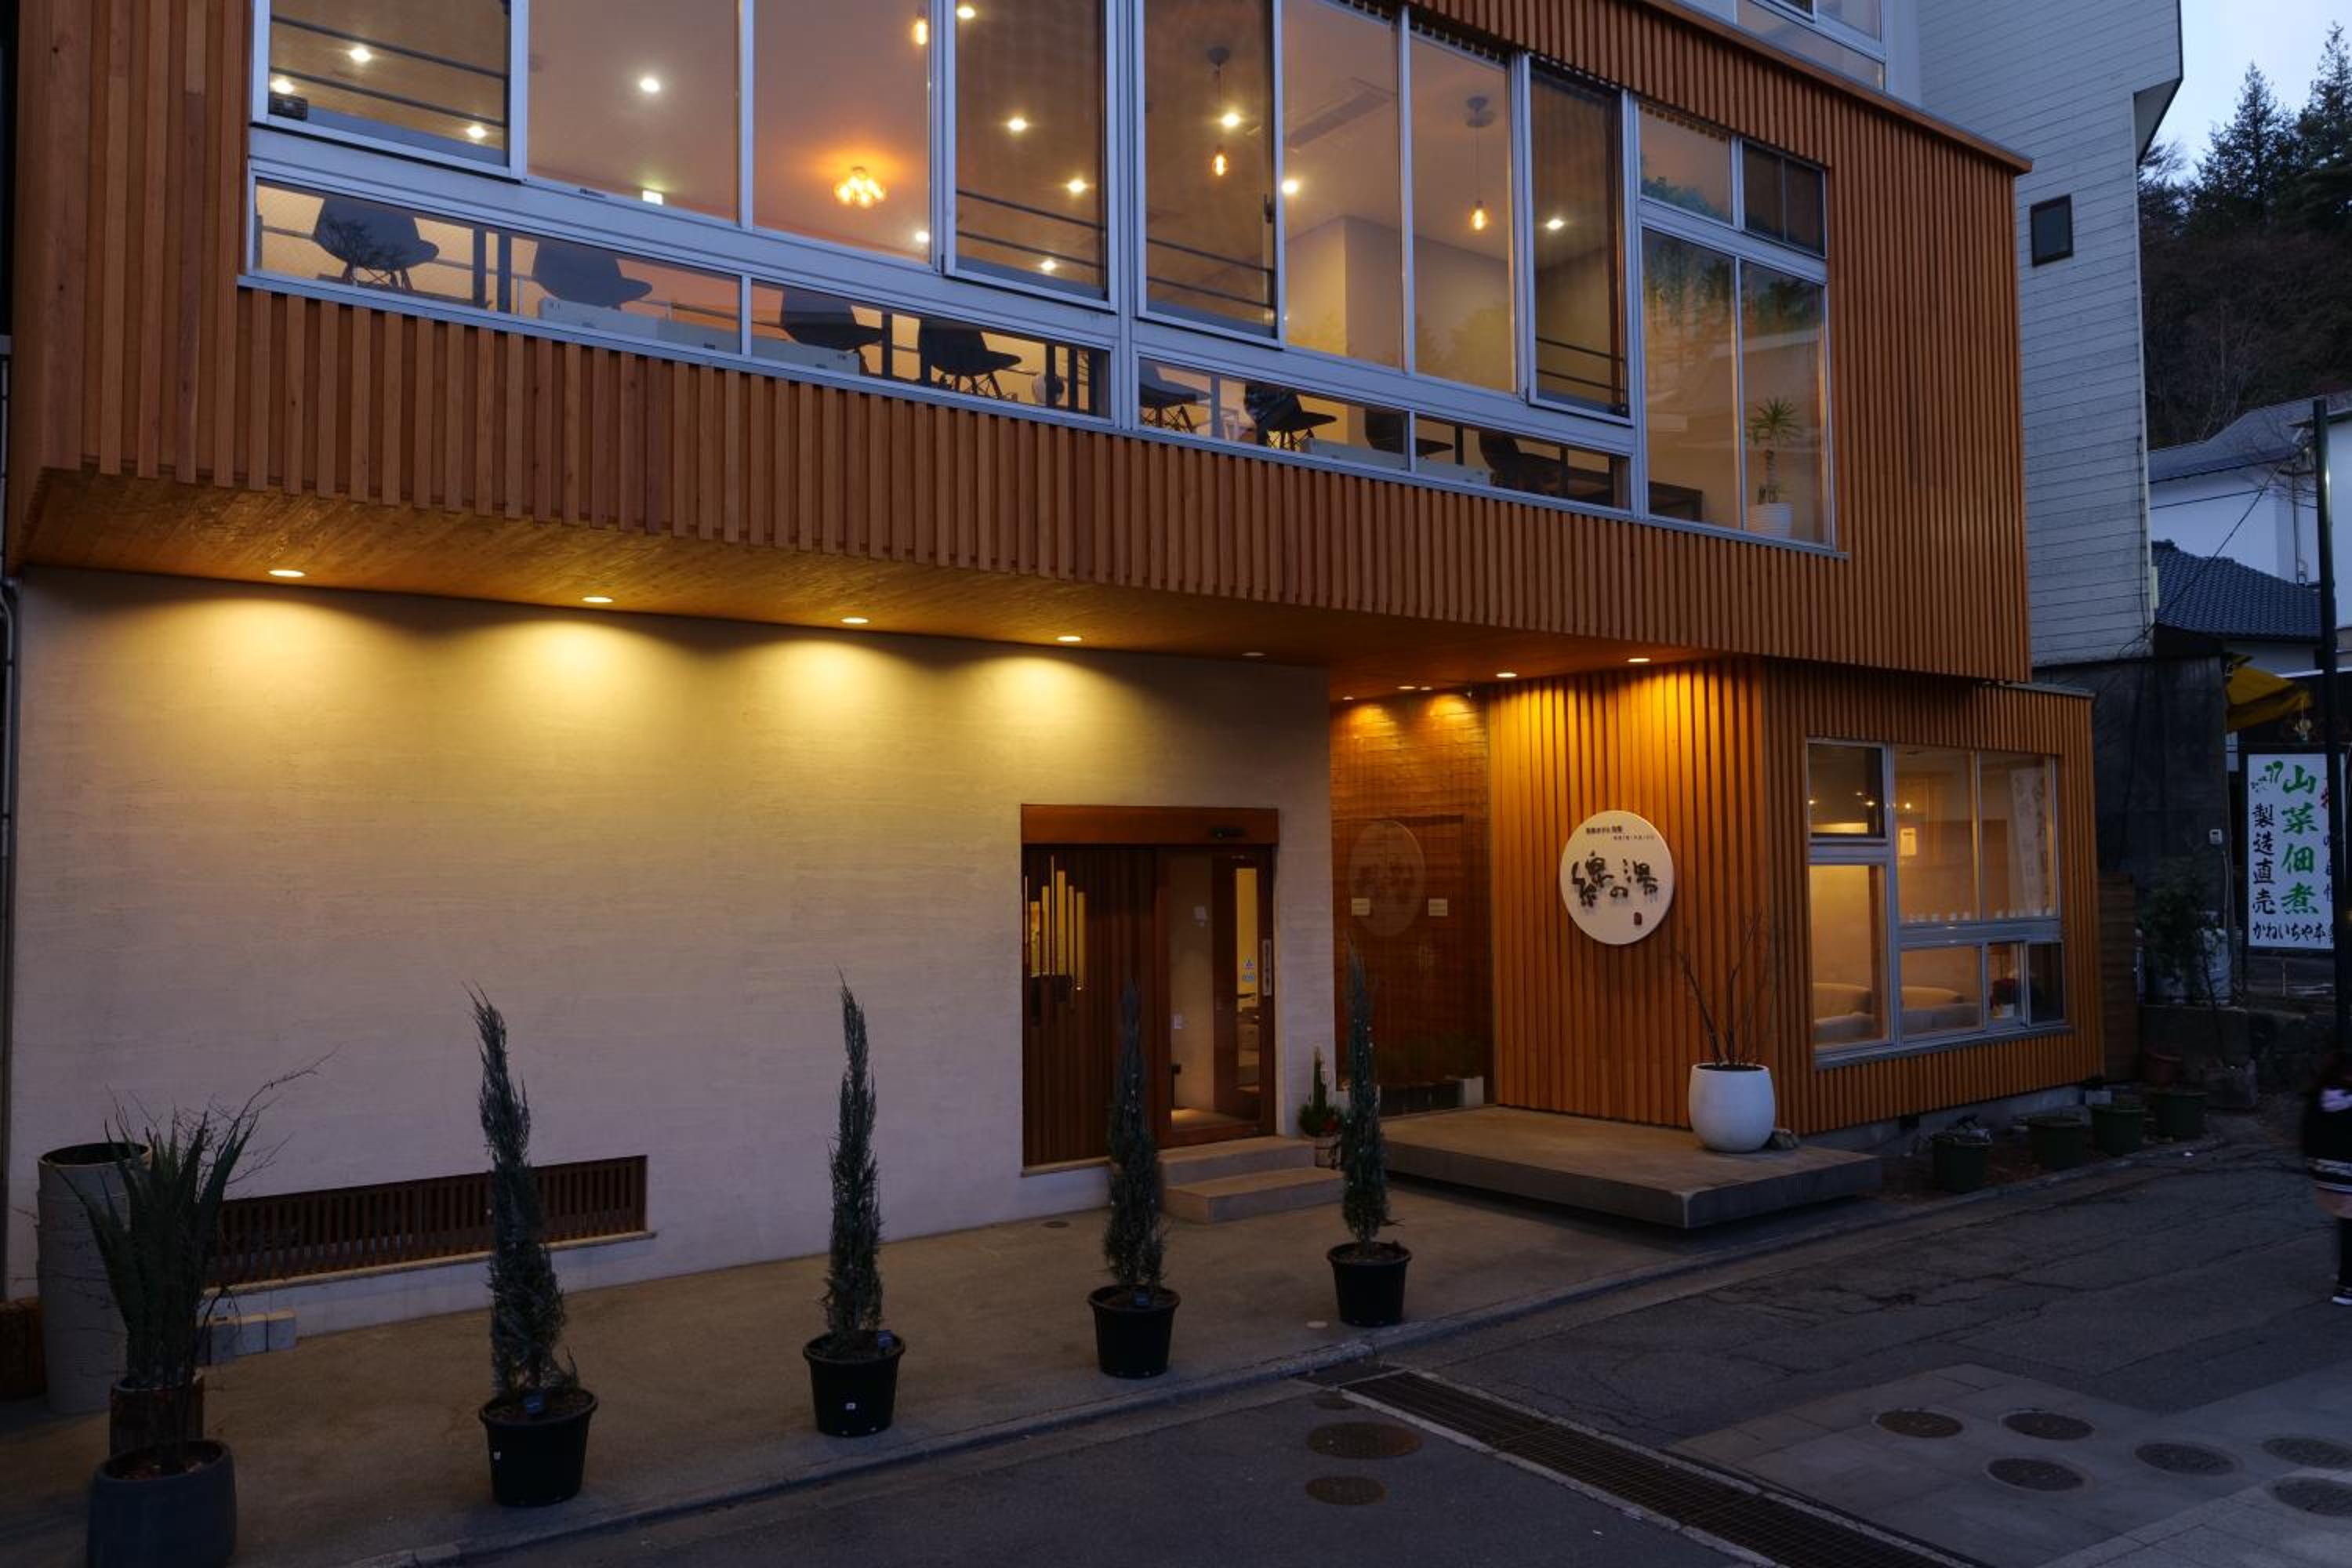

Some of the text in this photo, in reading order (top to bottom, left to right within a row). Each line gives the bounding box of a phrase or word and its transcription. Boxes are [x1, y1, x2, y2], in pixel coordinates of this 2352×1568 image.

[2252, 804, 2277, 916] 製造直売
[2281, 764, 2320, 916] 山菜佃煮
